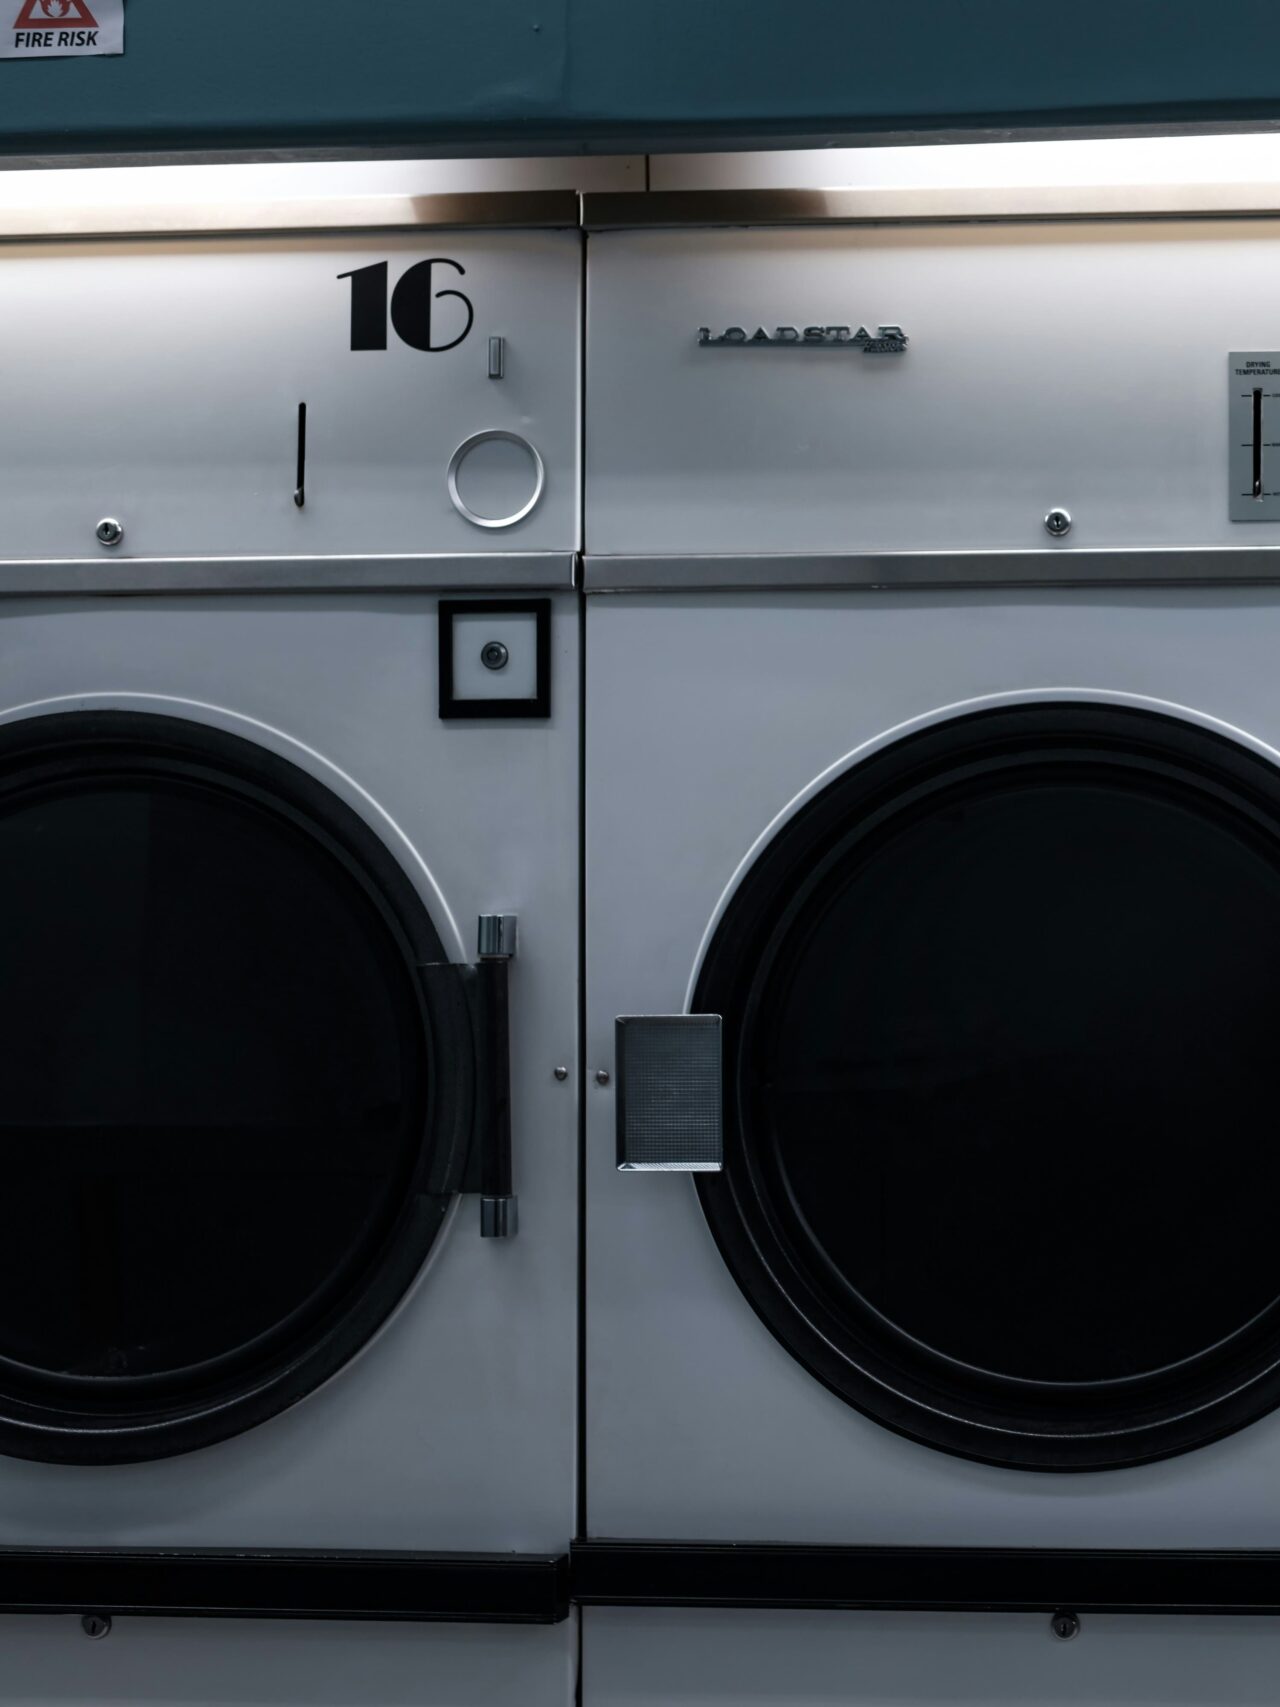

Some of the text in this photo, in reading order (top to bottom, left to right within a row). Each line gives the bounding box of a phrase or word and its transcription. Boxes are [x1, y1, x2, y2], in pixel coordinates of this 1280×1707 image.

[14, 30, 99, 48] FIRE RISK
[337, 258, 474, 353] 16
[698, 325, 907, 342] LOADSTAR
